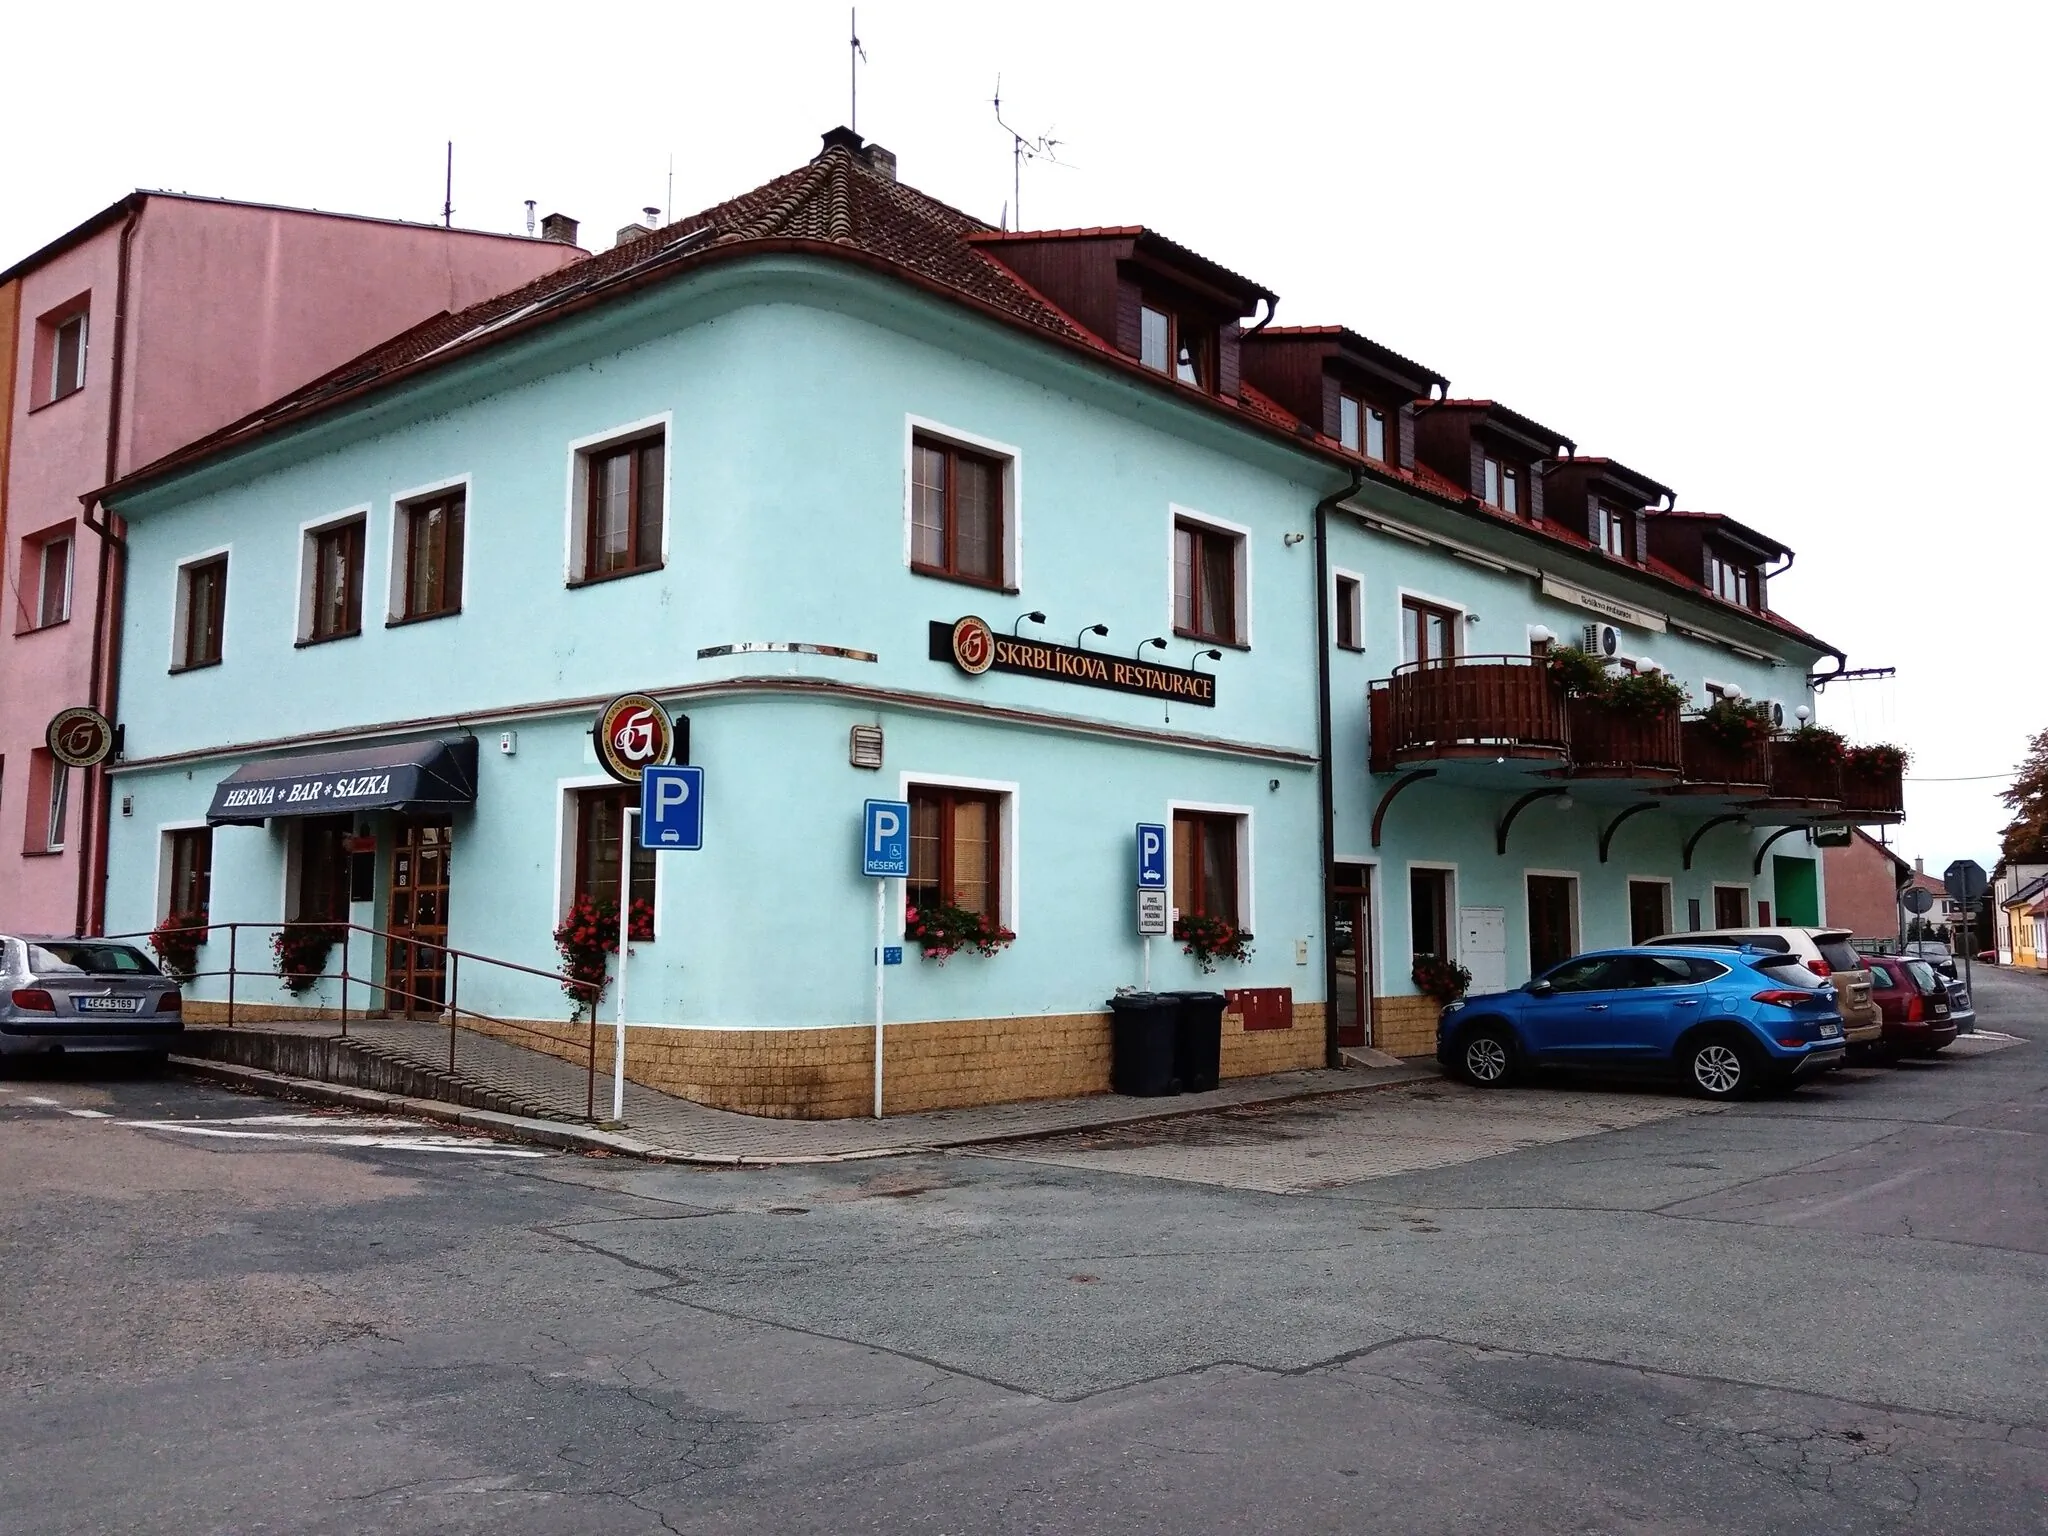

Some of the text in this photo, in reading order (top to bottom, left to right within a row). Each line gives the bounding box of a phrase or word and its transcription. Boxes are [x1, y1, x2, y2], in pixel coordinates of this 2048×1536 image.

[996, 640, 1212, 699] SKRBLÍKOVA RESTAURACE
[223, 774, 391, 807] HERNA BAR SAZKA
[655, 776, 690, 822] P
[874, 810, 900, 852] P
[868, 859, 904, 871] RÉSERVÉ
[1143, 832, 1160, 867] P
[111, 999, 132, 1008] 5169
